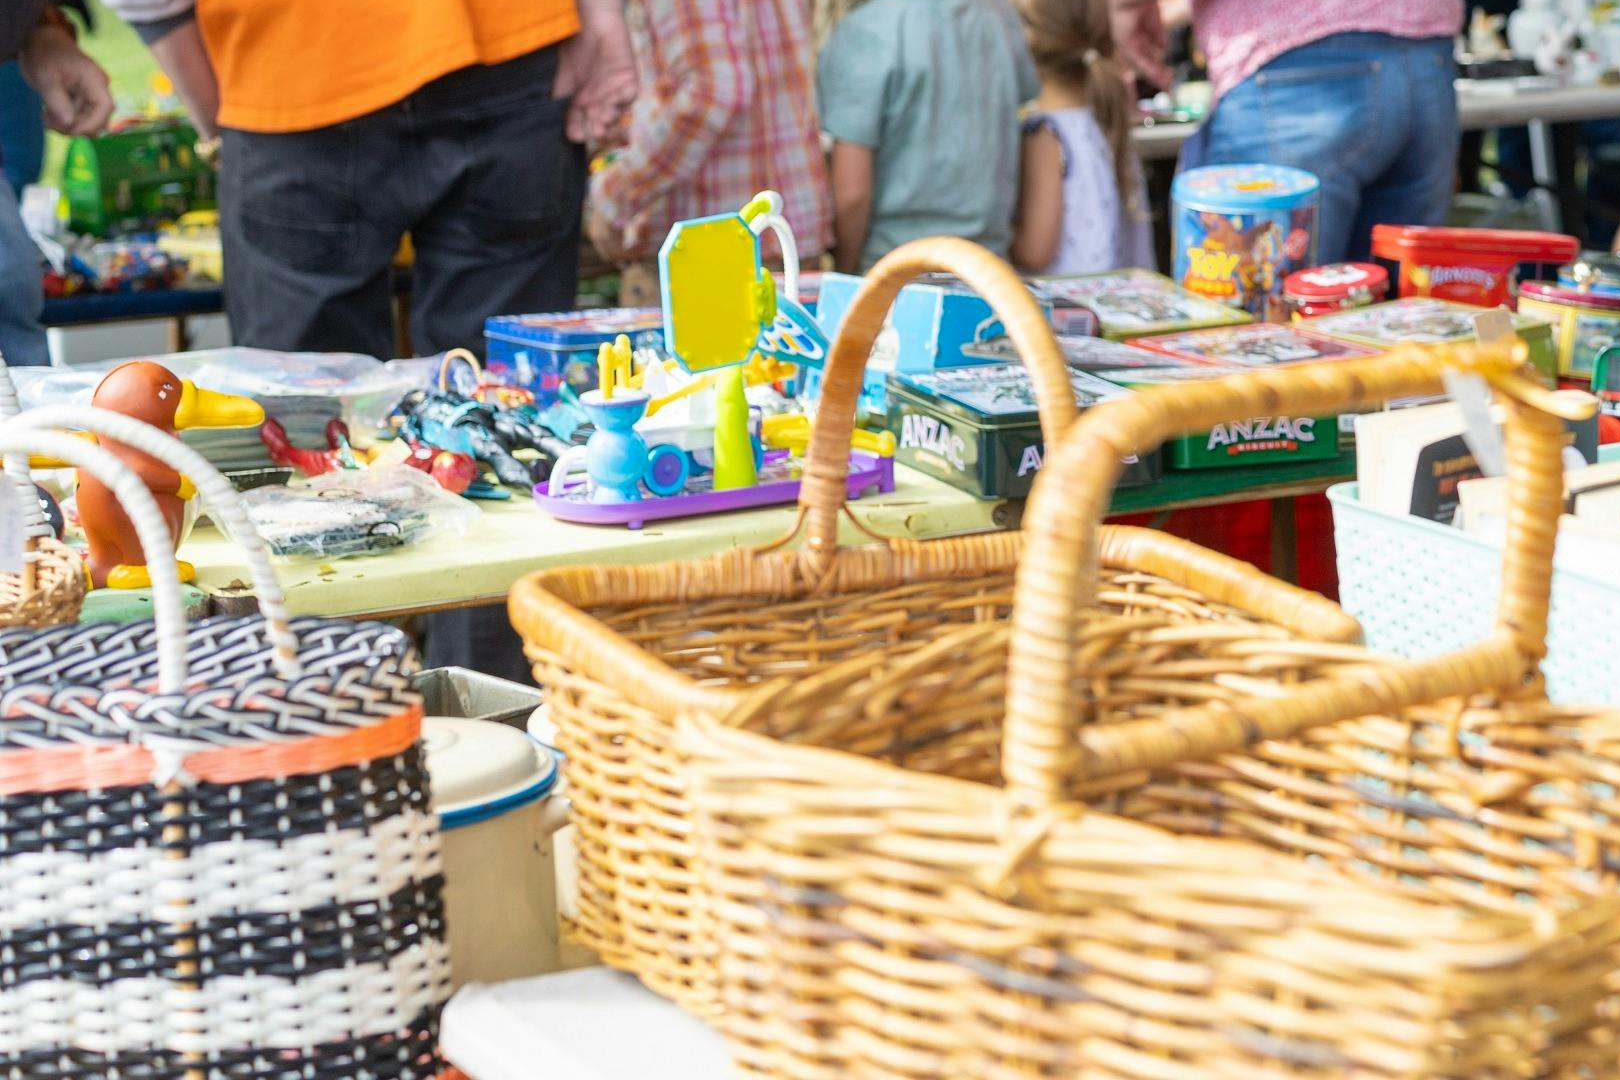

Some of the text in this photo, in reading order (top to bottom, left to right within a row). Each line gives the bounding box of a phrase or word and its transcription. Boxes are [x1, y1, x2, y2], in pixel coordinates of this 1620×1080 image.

[1187, 247, 1240, 280] TOY
[900, 414, 966, 472] ANZAC
[1207, 416, 1316, 451] ANZAC
